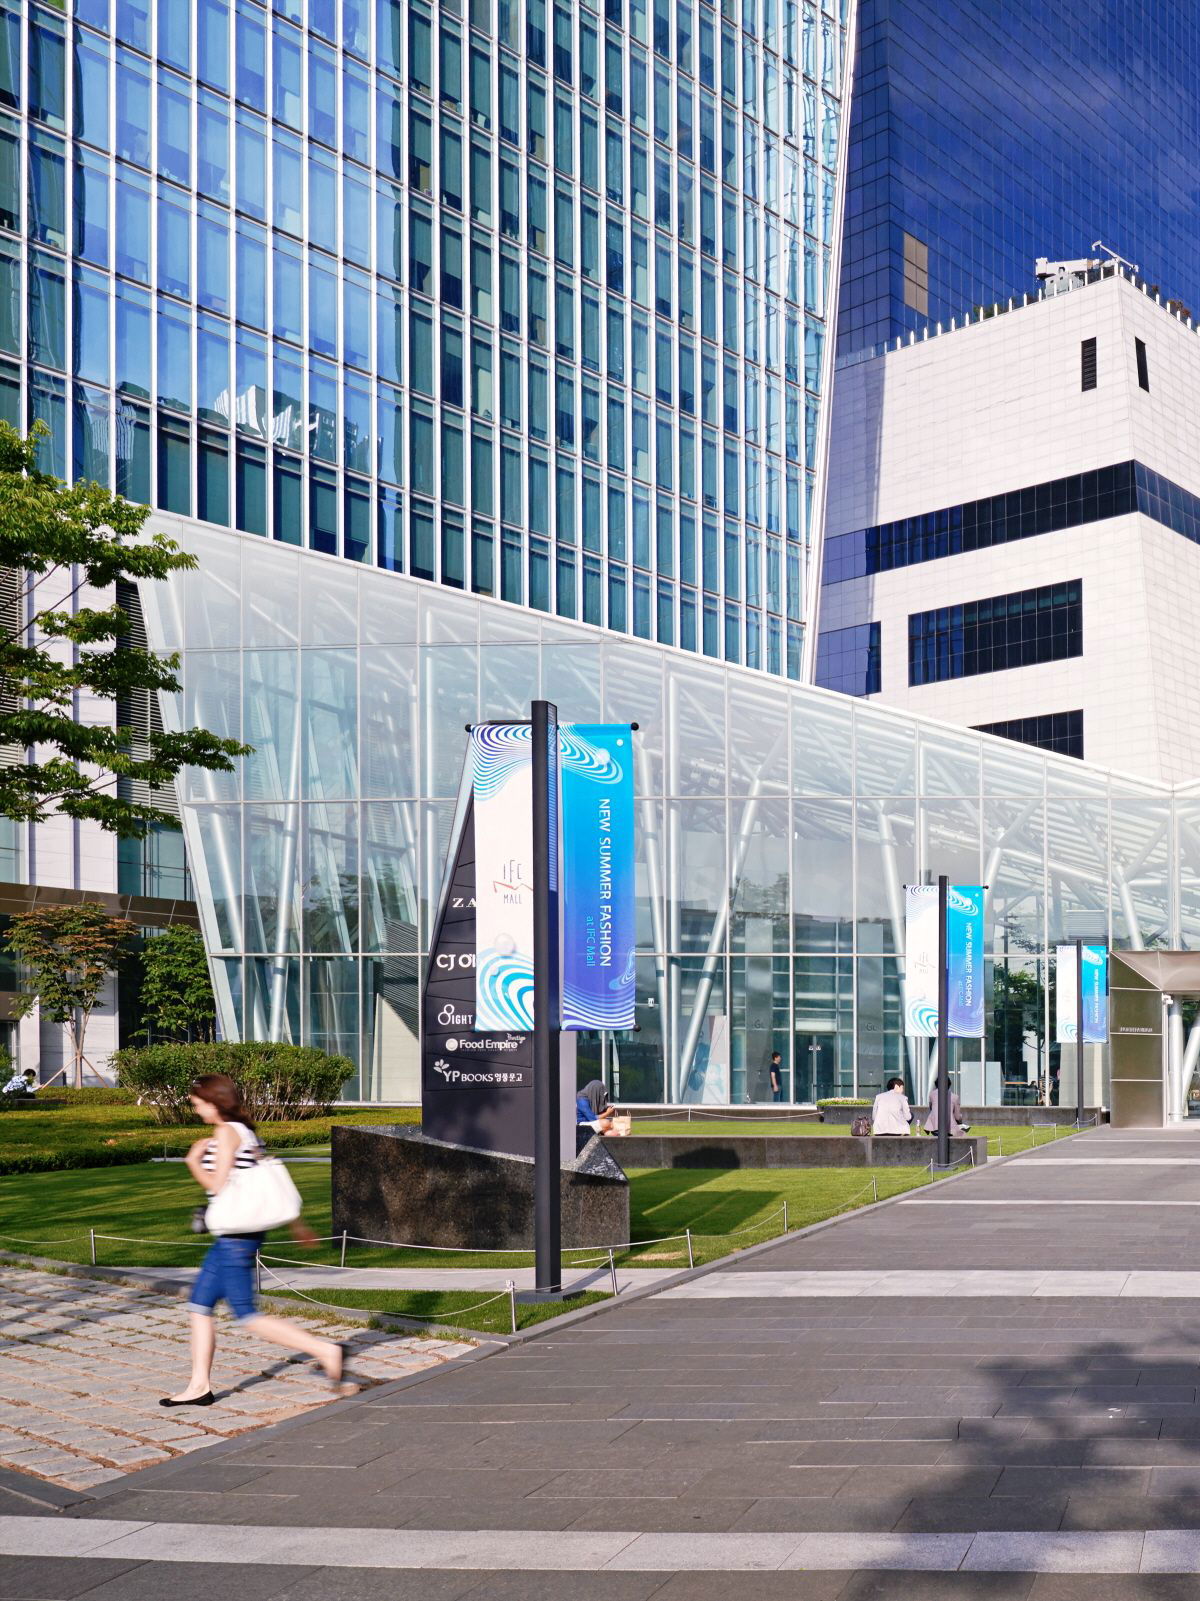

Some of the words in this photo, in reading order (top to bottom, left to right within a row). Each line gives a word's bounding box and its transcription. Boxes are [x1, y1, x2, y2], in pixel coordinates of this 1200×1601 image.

[598, 798, 611, 832] NEW
[503, 859, 522, 883] IFC
[599, 837, 612, 900] SUMMER
[452, 897, 476, 908] ZA
[503, 893, 522, 904] MALL
[586, 915, 594, 926] at
[586, 928, 596, 943] IFC
[599, 904, 612, 967] FASHION
[965, 922, 973, 940] NEW
[436, 953, 456, 971] CJ
[586, 945, 596, 967] Mall
[965, 941, 973, 973] SUMMER
[965, 975, 973, 1007] FASHION
[459, 1039, 484, 1049] Food
[485, 1039, 518, 1052] Empire
[443, 1070, 460, 1082] YP
[461, 1073, 493, 1082] BOOKS
[494, 1072, 523, 1083] 영풍문고
